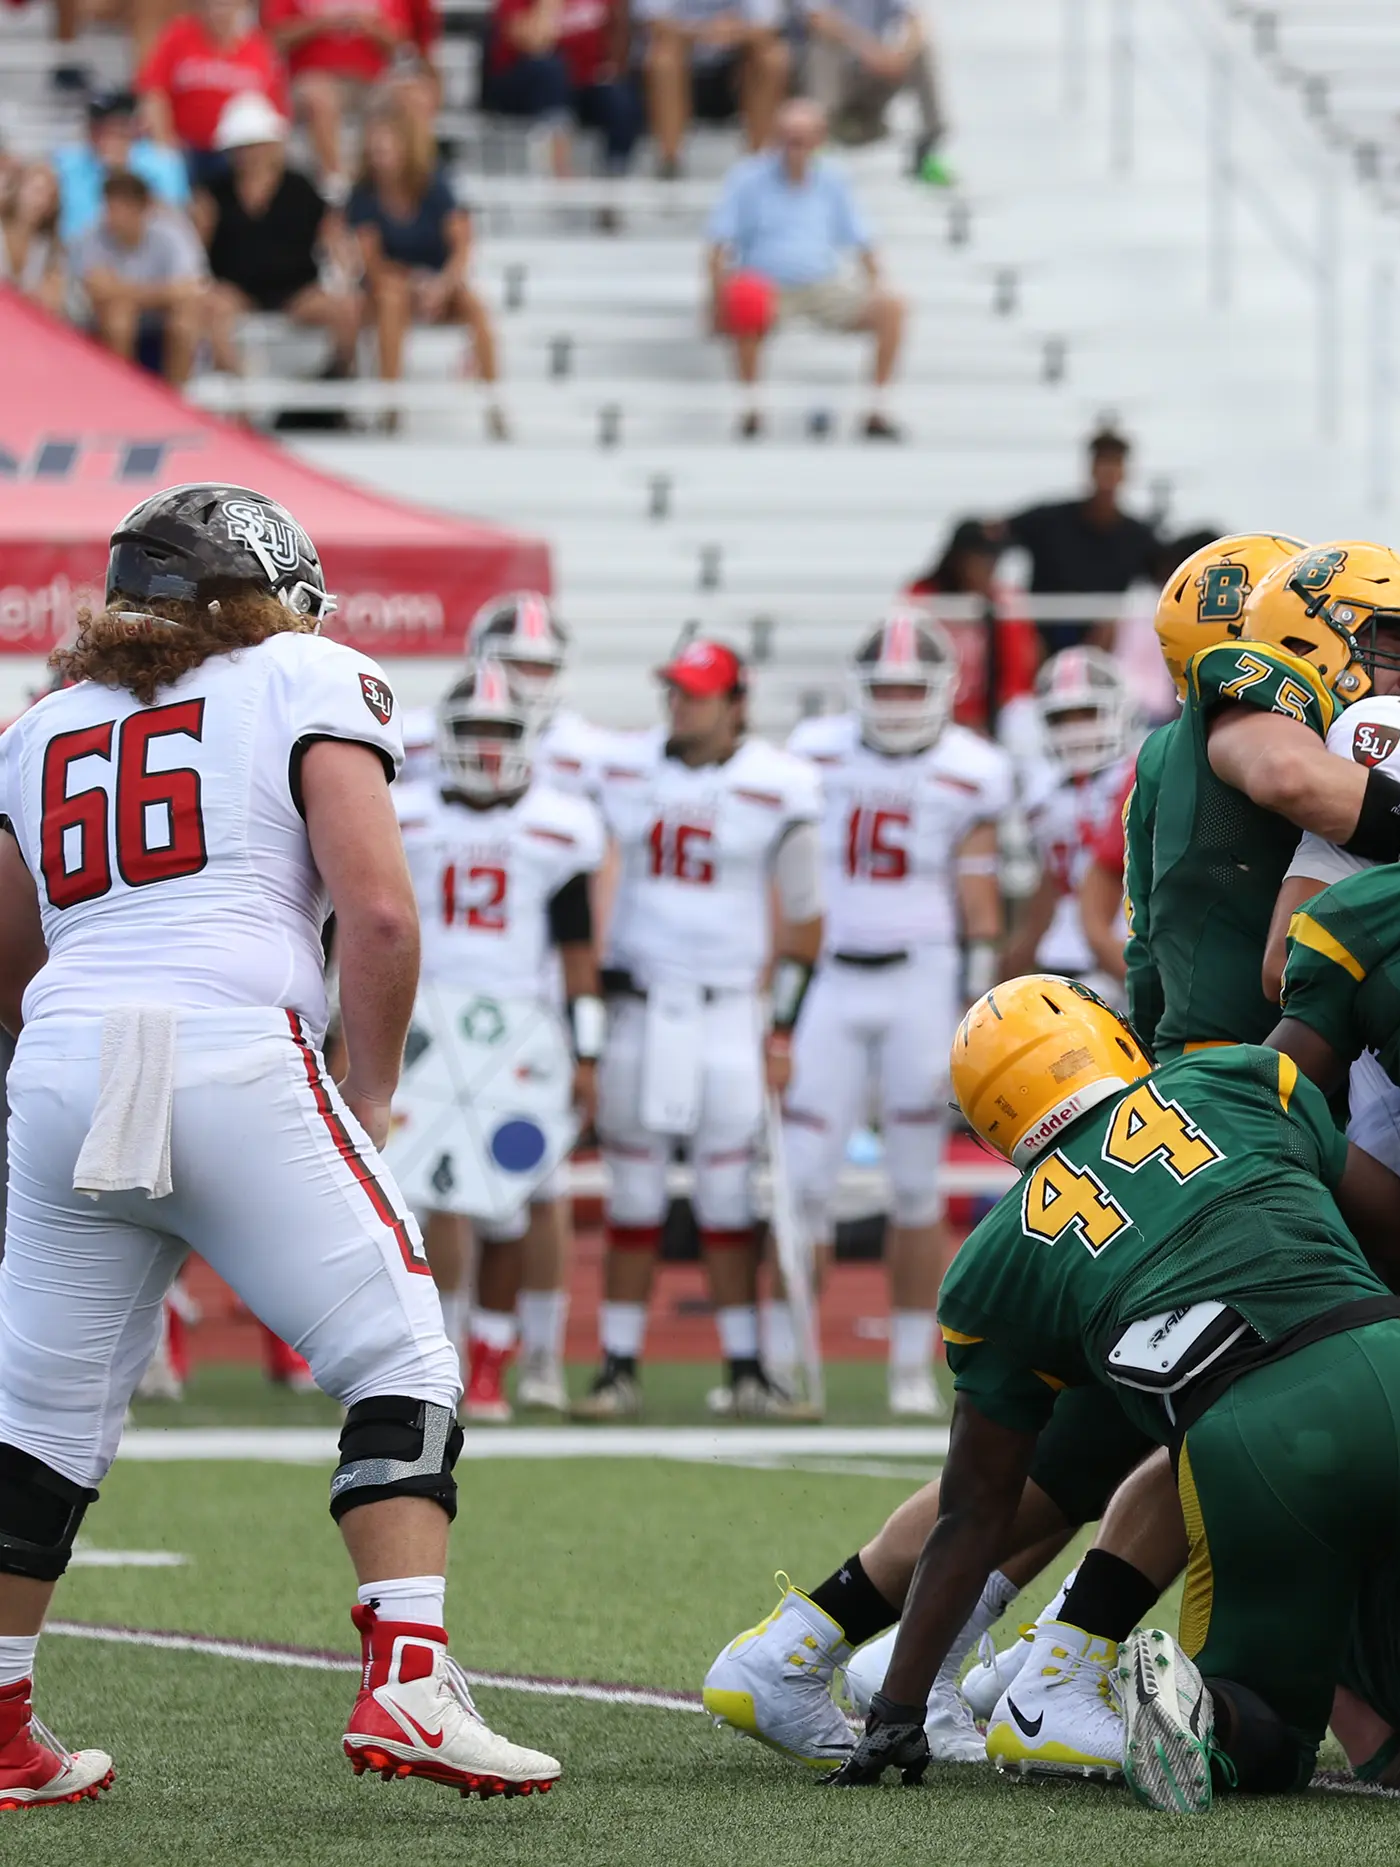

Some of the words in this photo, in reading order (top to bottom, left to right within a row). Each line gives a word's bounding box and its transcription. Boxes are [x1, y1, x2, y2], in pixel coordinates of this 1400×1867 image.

[1197, 562, 1250, 623] B
[1283, 550, 1349, 592] B
[40, 697, 208, 910] 66
[648, 819, 716, 885] 16
[846, 805, 910, 881] 15
[441, 865, 508, 930] 12
[1021, 1079, 1228, 1259] 44
